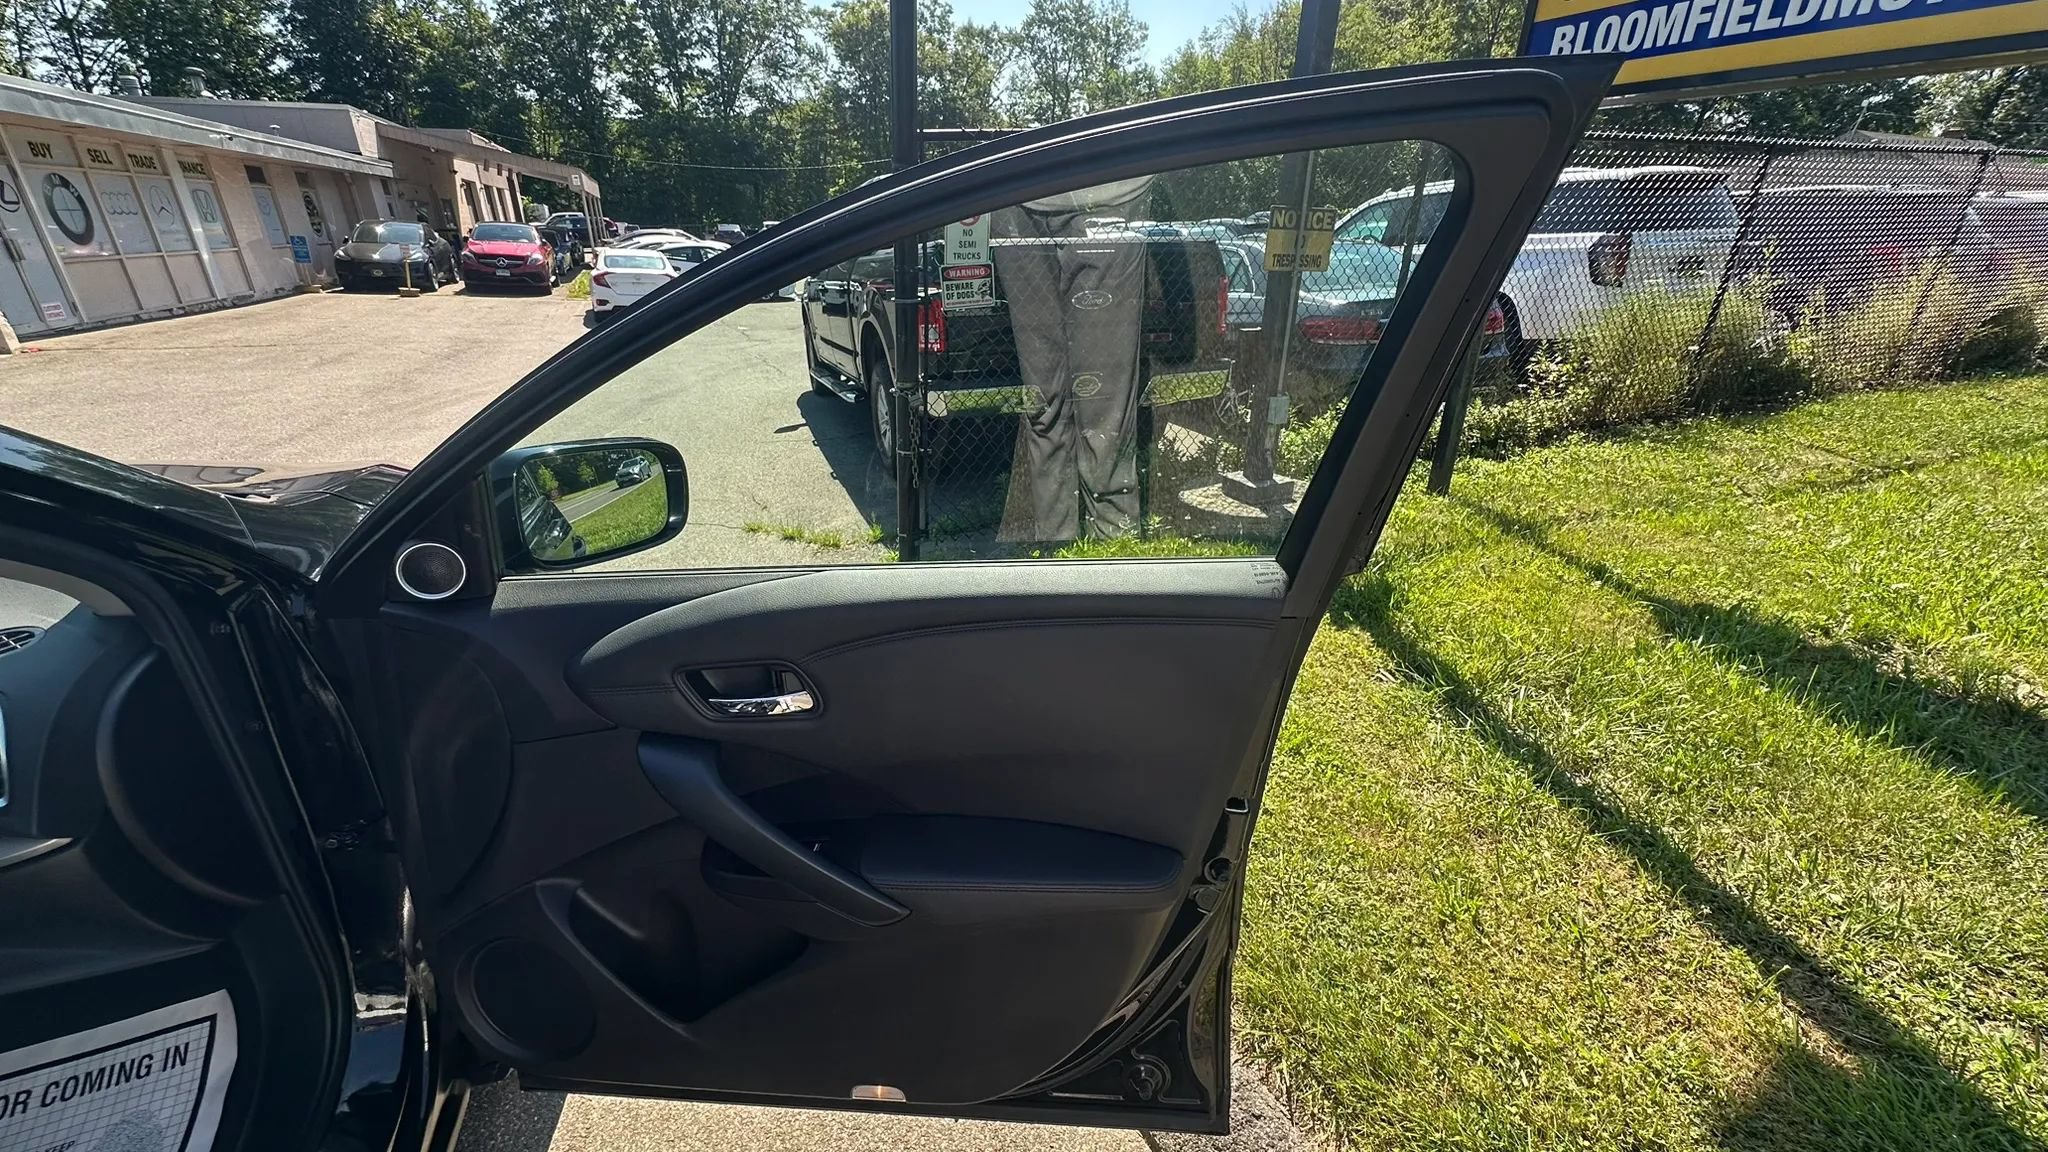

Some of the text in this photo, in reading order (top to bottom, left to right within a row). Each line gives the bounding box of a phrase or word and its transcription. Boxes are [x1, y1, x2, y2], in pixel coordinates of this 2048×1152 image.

[1550, 0, 1939, 56] BLOOMFIELD
[27, 141, 53, 159] BUY
[87, 148, 114, 165] SELL
[128, 153, 157, 170] TRADE
[177, 159, 206, 175] INANCE
[1272, 209, 1334, 230] NOICE
[962, 229, 974, 237] NO
[958, 241, 977, 249] SEMI
[953, 252, 981, 260] TRUCKS
[1272, 253, 1322, 269] TRESPSSING
[948, 268, 985, 278] WARNING
[945, 282, 974, 292] BEWARE
[946, 290, 975, 300] OF DOGS
[40, 1053, 153, 1108] COMING
[162, 1042, 190, 1072] IN
